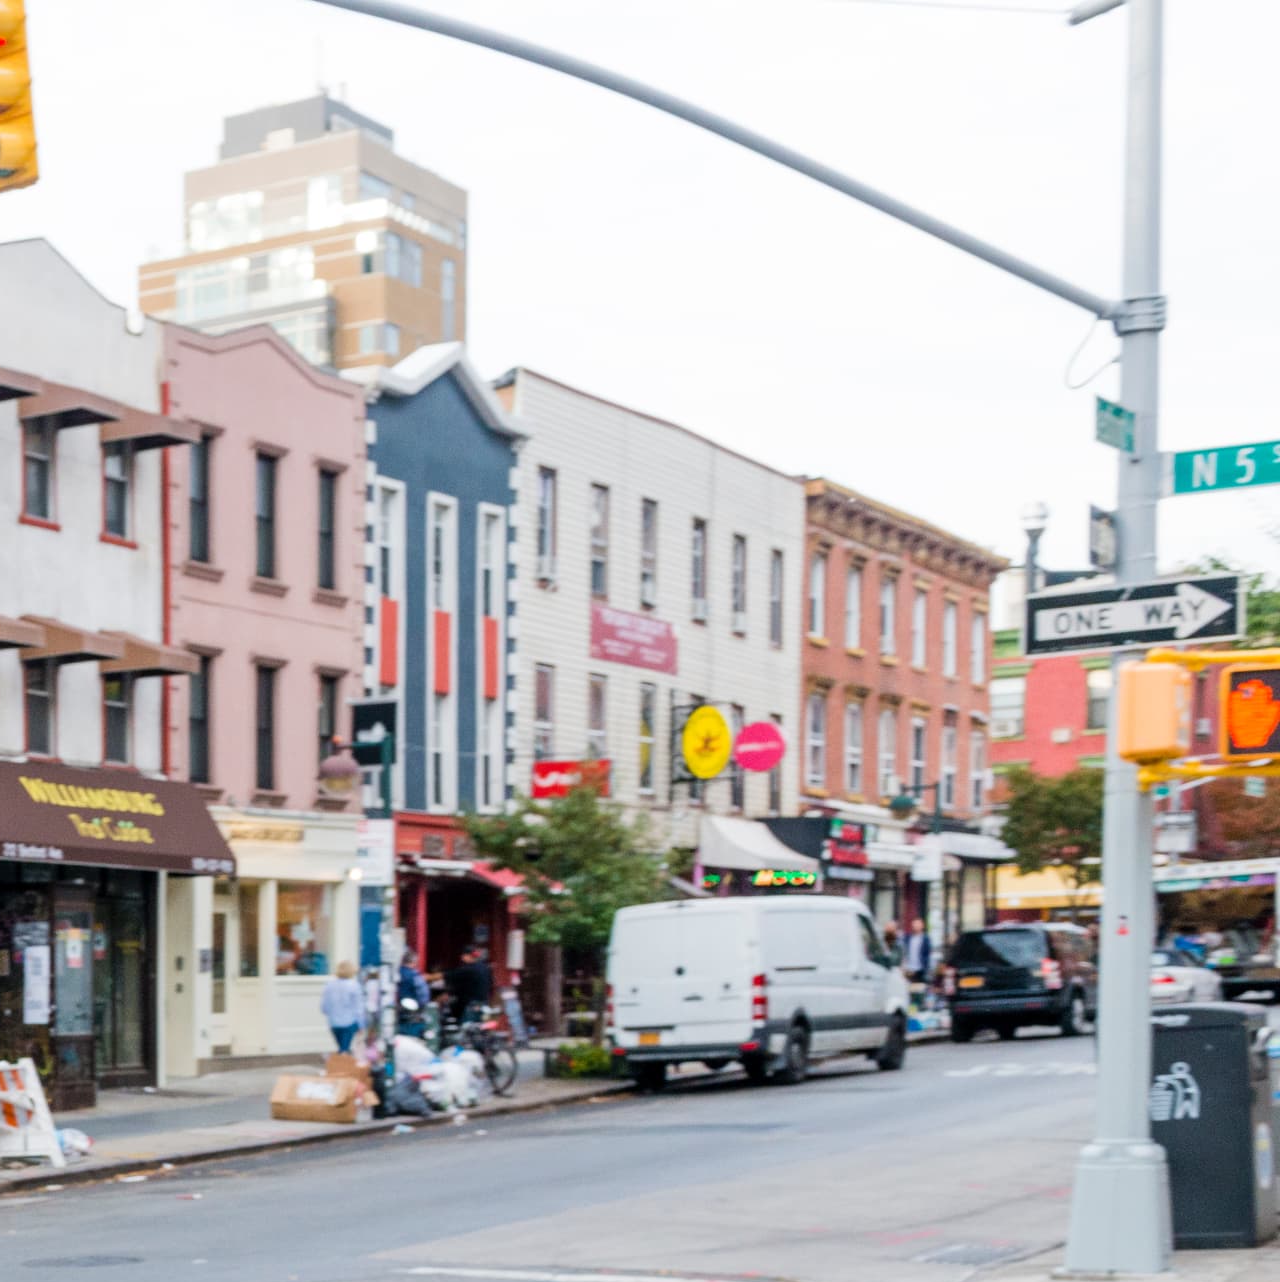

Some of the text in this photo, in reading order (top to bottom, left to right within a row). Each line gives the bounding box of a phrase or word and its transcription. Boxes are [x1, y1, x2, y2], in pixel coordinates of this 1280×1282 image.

[1192, 452, 1219, 488] N
[1235, 447, 1257, 484] 5
[1054, 599, 1209, 634] ONE WAY
[18, 776, 166, 816] WILLIAMSBURG
